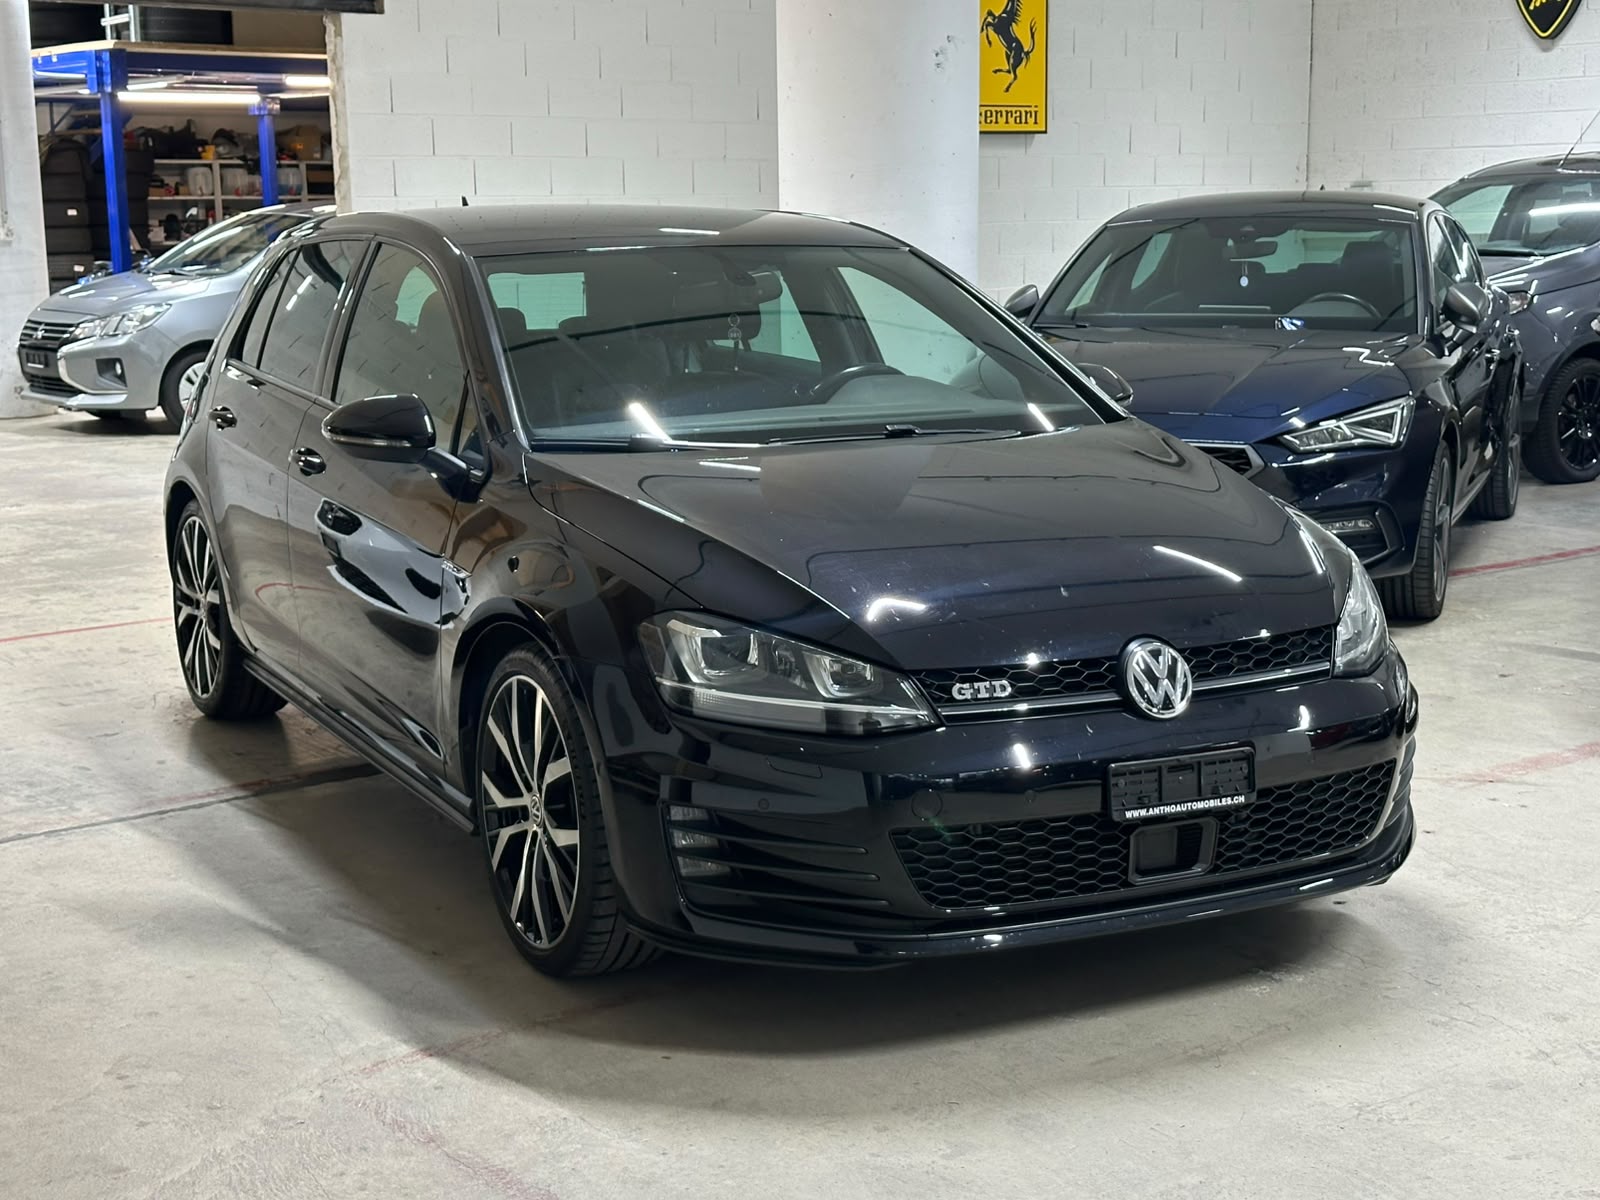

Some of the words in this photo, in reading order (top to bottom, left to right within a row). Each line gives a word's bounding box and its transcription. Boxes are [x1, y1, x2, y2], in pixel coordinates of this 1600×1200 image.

[979, 104, 1039, 125] errari
[1128, 642, 1189, 714] VW
[951, 680, 1012, 700] GTD
[1125, 795, 1245, 819] WWW.ANTHOAUTOMOBILES.CH
